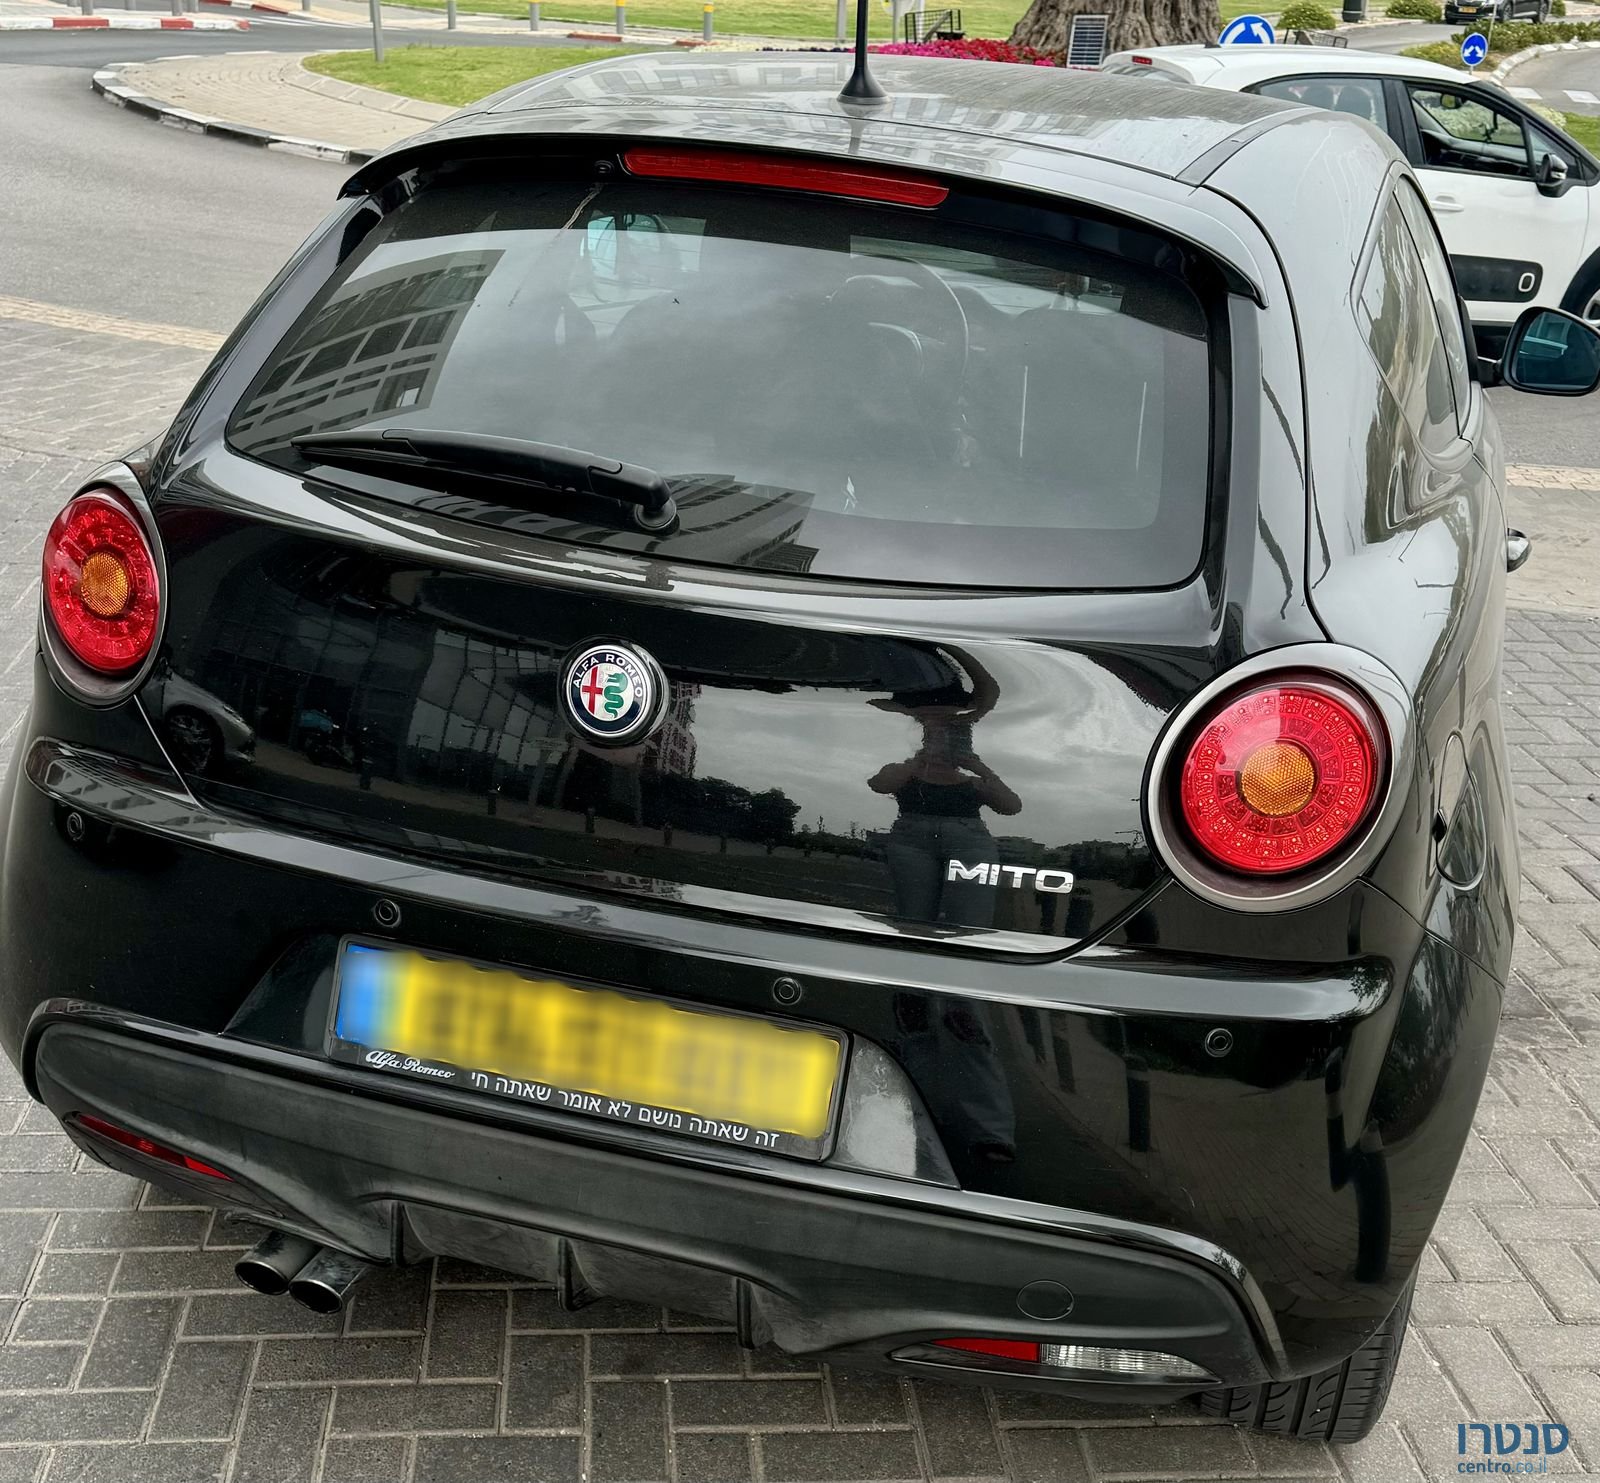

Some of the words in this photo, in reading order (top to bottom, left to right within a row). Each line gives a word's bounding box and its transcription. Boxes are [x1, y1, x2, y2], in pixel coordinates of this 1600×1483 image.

[573, 656, 599, 688] ALFA
[605, 654, 643, 698] ROMEO
[948, 859, 1073, 894] MITO
[365, 1050, 402, 1069] Alfa
[401, 1056, 455, 1078] Romeo
[471, 1071, 488, 1089] חי
[495, 1077, 551, 1101] שאתה
[558, 1090, 602, 1113] אומר
[608, 1100, 632, 1118] לא
[638, 1107, 681, 1129] נושם
[689, 1117, 749, 1142] שאתה
[755, 1130, 780, 1147] זה
